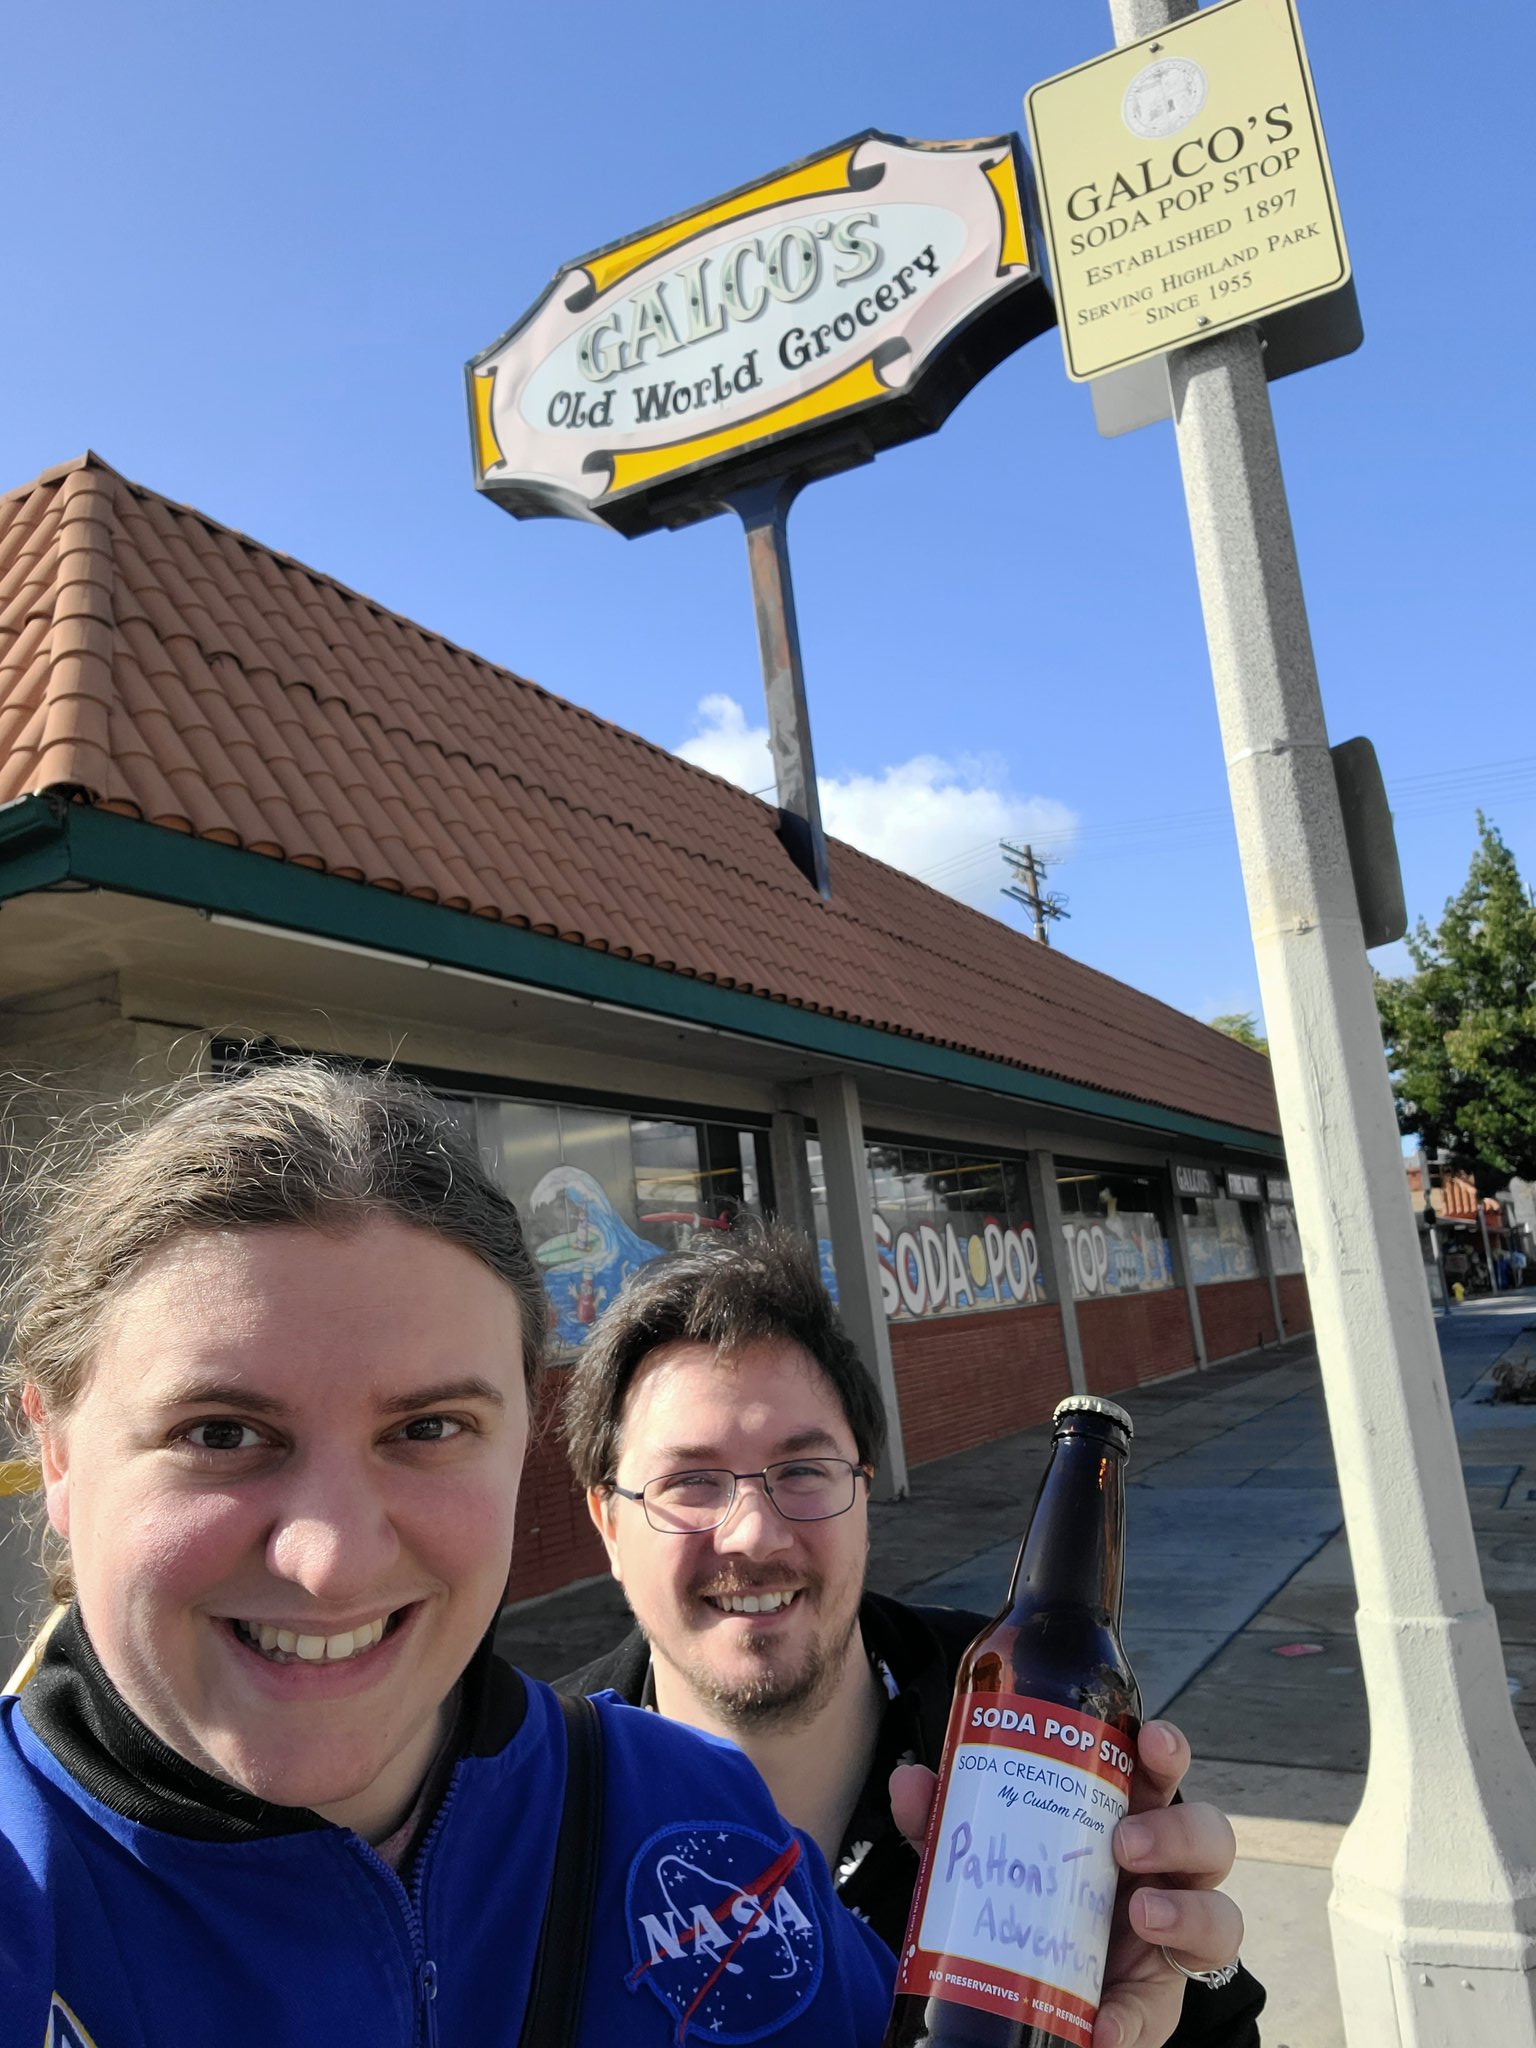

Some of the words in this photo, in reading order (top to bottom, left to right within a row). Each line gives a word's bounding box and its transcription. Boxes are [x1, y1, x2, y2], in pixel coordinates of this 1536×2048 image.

[1066, 103, 1293, 222] GALCO'S
[1070, 209, 1152, 256] SODA
[1158, 181, 1214, 220] POP
[1223, 147, 1301, 193] STOP
[1077, 287, 1153, 326] SERVING
[1161, 246, 1259, 293] HIGHLAND
[1266, 222, 1321, 253] PARK
[1086, 218, 1232, 286] ESTABLISHED
[1245, 188, 1298, 224] 1897
[575, 212, 883, 381] GALCO'S
[634, 349, 763, 425] World
[778, 244, 939, 372] Grocery
[1146, 295, 1200, 325] SINCE
[1209, 271, 1253, 301] 1955
[872, 1213, 975, 1316] SODA
[983, 1223, 1039, 1303] POP
[1061, 1223, 1108, 1296] TOP
[958, 1755, 998, 1773] SODA
[1003, 1760, 1088, 1799] CREATION
[971, 1706, 1036, 1735] SODA
[1043, 1718, 1095, 1752] POP
[1099, 1739, 1134, 1777] STOP
[997, 1784, 1019, 1808] My
[1022, 1790, 1071, 1818] Custom
[1072, 1807, 1105, 1834] Flavor
[638, 1885, 813, 1966] NASA
[928, 1969, 943, 1982] NO
[944, 1972, 1020, 2003] PRESERVATIVES
[1031, 1998, 1055, 2015] KEEP
